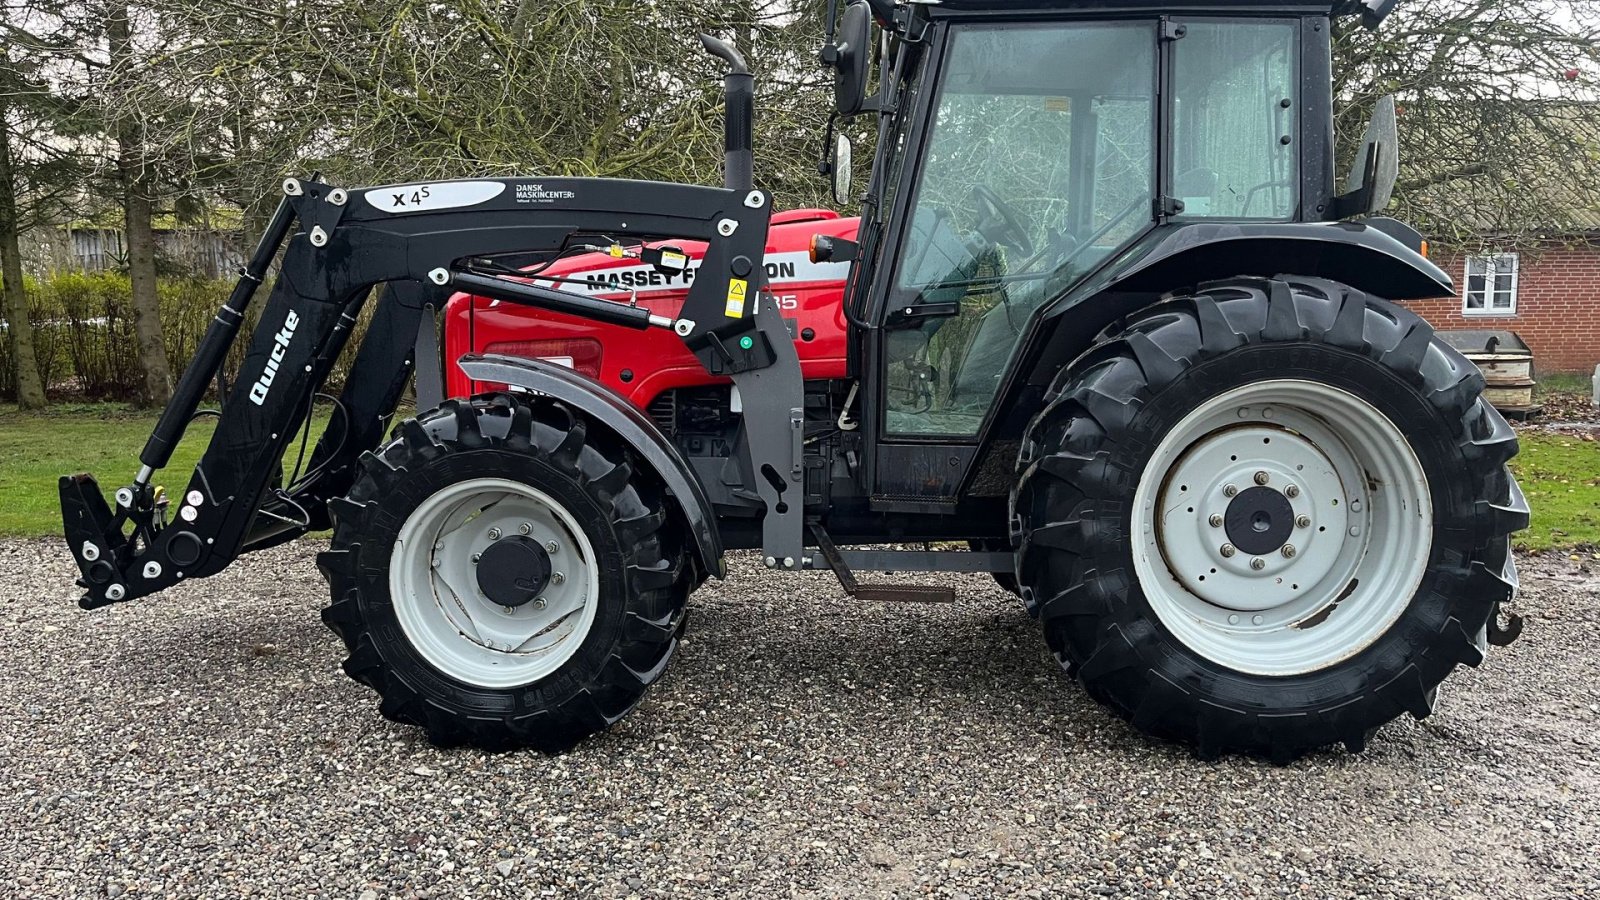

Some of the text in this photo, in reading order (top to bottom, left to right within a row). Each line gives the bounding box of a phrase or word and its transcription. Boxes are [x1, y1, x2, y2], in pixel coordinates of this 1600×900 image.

[516, 184, 543, 192] DANSK
[587, 270, 672, 291] MASSEY
[249, 310, 300, 406] Quicke
